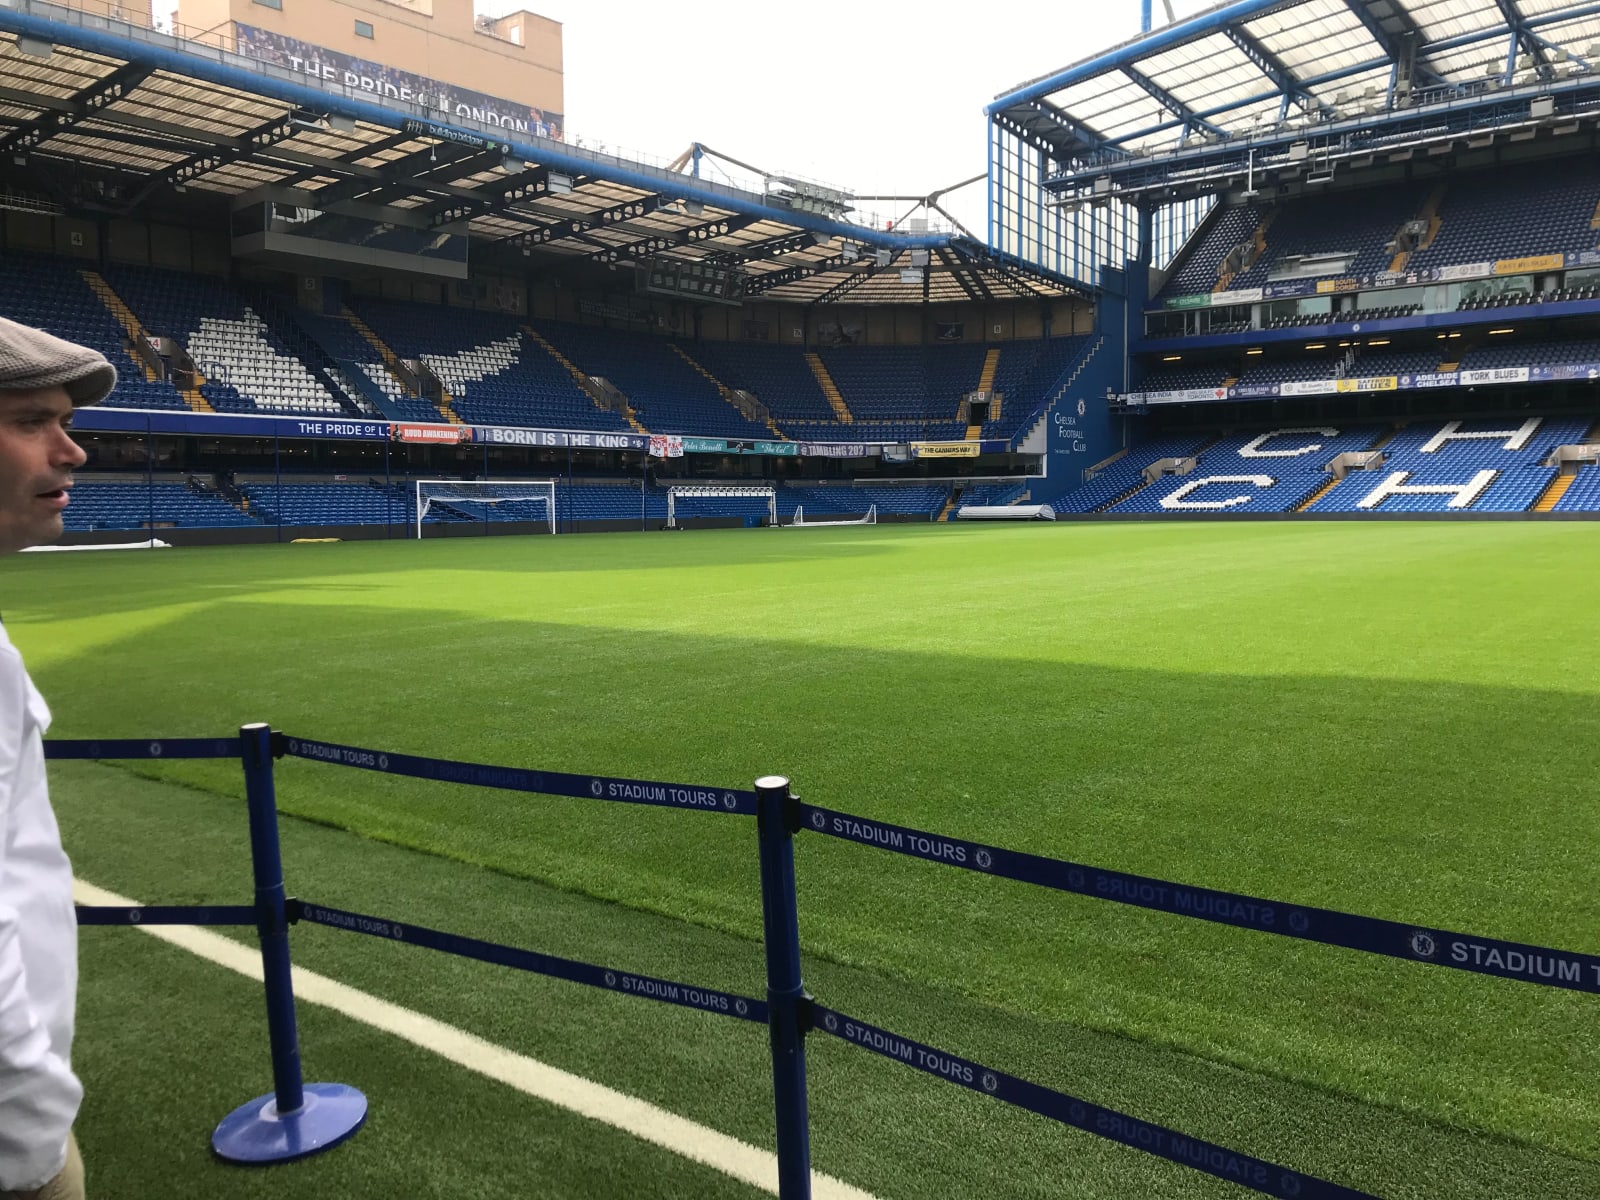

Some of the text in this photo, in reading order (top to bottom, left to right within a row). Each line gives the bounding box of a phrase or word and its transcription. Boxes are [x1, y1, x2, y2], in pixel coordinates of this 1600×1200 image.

[288, 55, 335, 79] THE
[344, 71, 411, 101] PRIDE
[1336, 277, 1357, 285] SOUTH
[1375, 271, 1407, 281] CORNISH
[1375, 279, 1397, 287] BLUES
[1335, 283, 1360, 291] DORSET
[1416, 372, 1458, 381] ADELAIDE
[1470, 369, 1519, 381] YORK BLUES
[1416, 379, 1457, 388] CHELSEA
[1054, 412, 1076, 426] CHELSEA
[298, 423, 322, 434] THE
[326, 424, 362, 436] PRIDE
[364, 425, 376, 434] OF
[1059, 425, 1084, 439] FOOTBALL
[493, 429, 628, 448] BORN IS THE KING
[1073, 439, 1087, 452] CLUB
[848, 445, 864, 456] 202
[302, 742, 374, 766] STADIUM TOURS
[608, 782, 717, 807] STADIUM TOURS
[833, 817, 967, 862] STADIUM TOURS
[316, 909, 389, 936] STADIUM TOURS
[1451, 941, 1581, 983] STADIUM
[621, 975, 729, 1011] STADIUM TOURS
[845, 1022, 974, 1083] STADIUM TOURS
